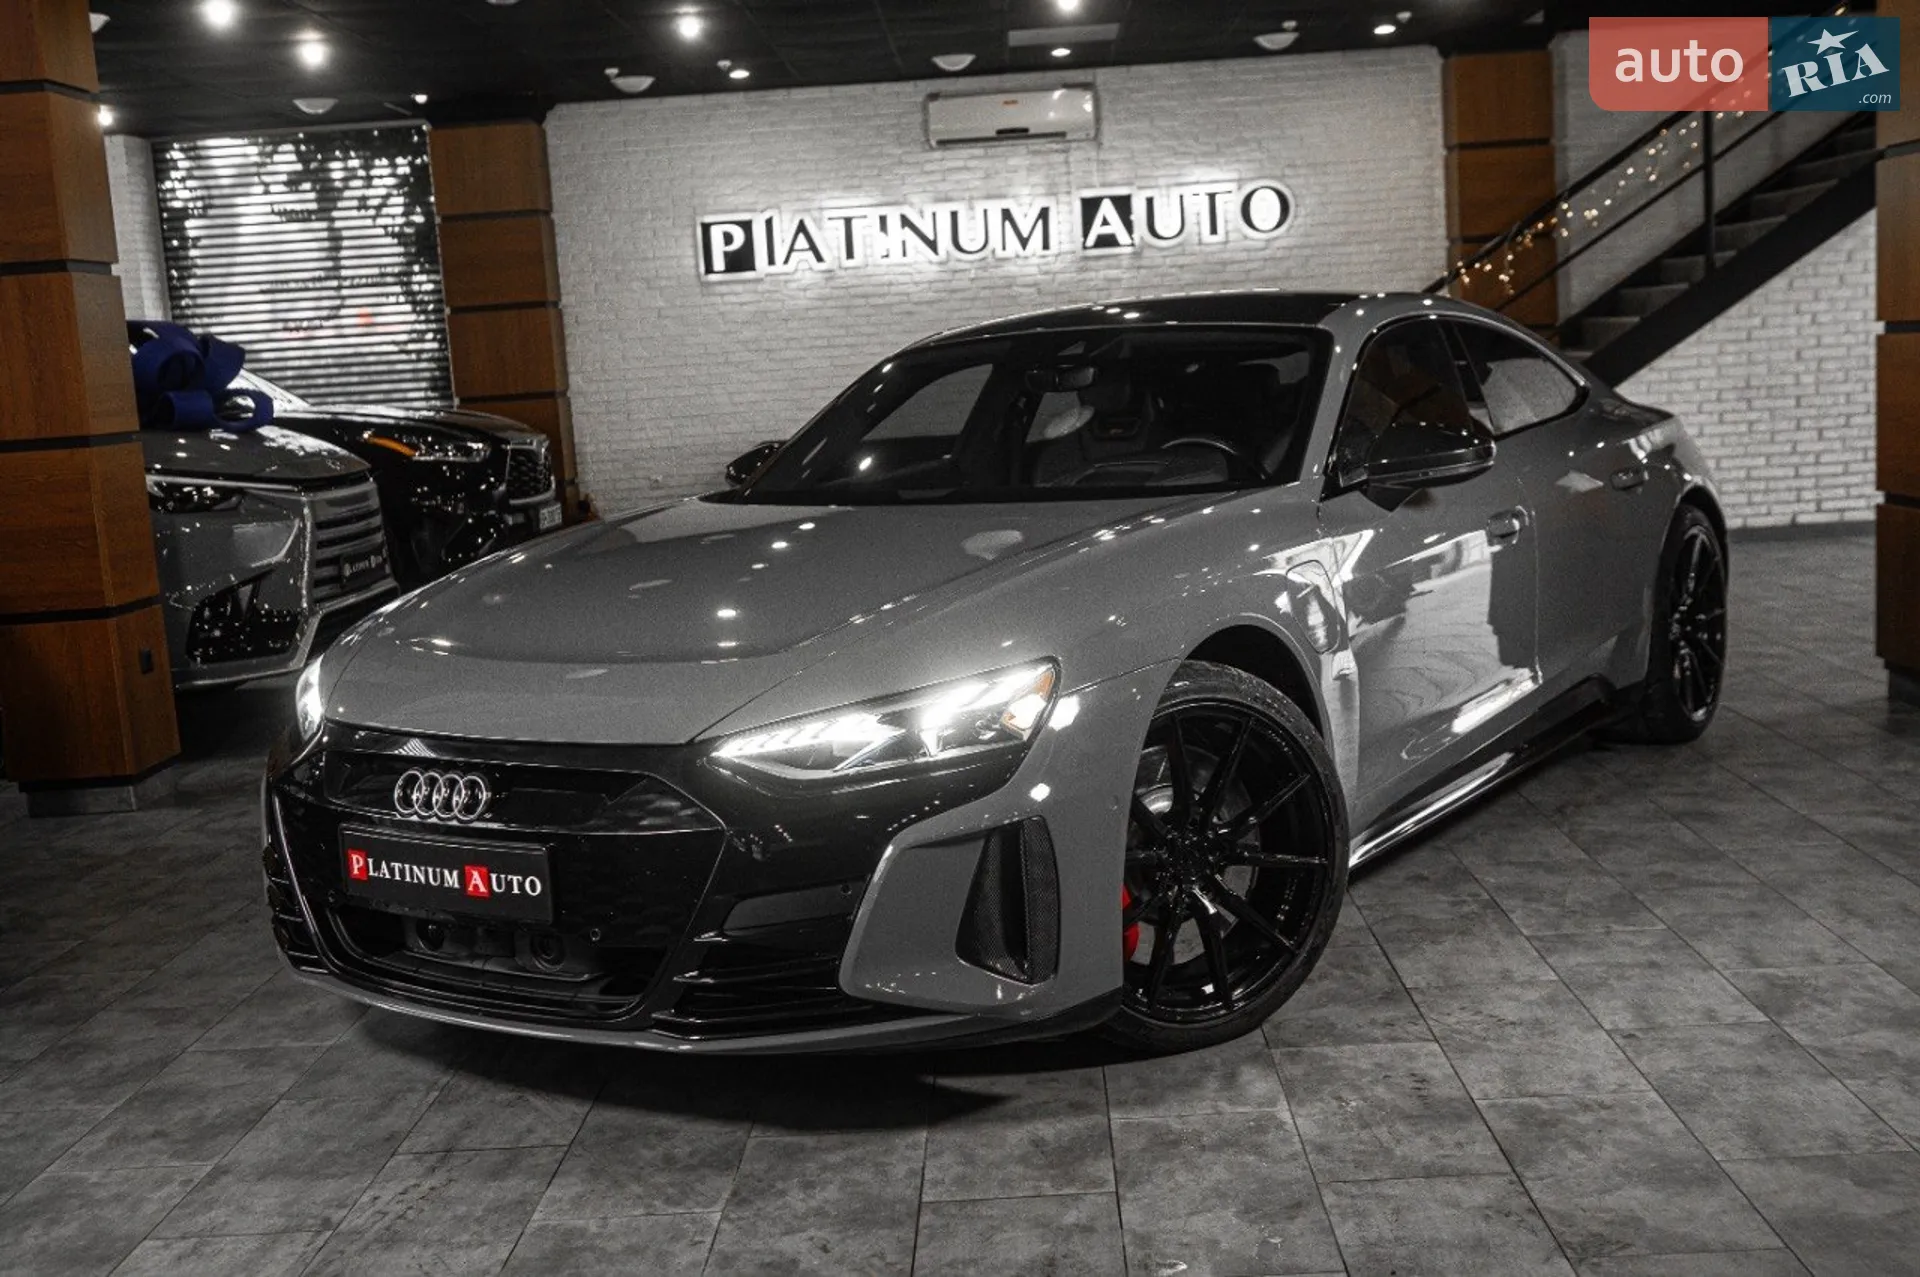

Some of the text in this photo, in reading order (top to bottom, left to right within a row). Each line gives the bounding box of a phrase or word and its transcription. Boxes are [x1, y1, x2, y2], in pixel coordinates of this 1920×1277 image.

[1081, 185, 1291, 248] AUTO
[351, 853, 541, 896] PLATINUM AUTO
